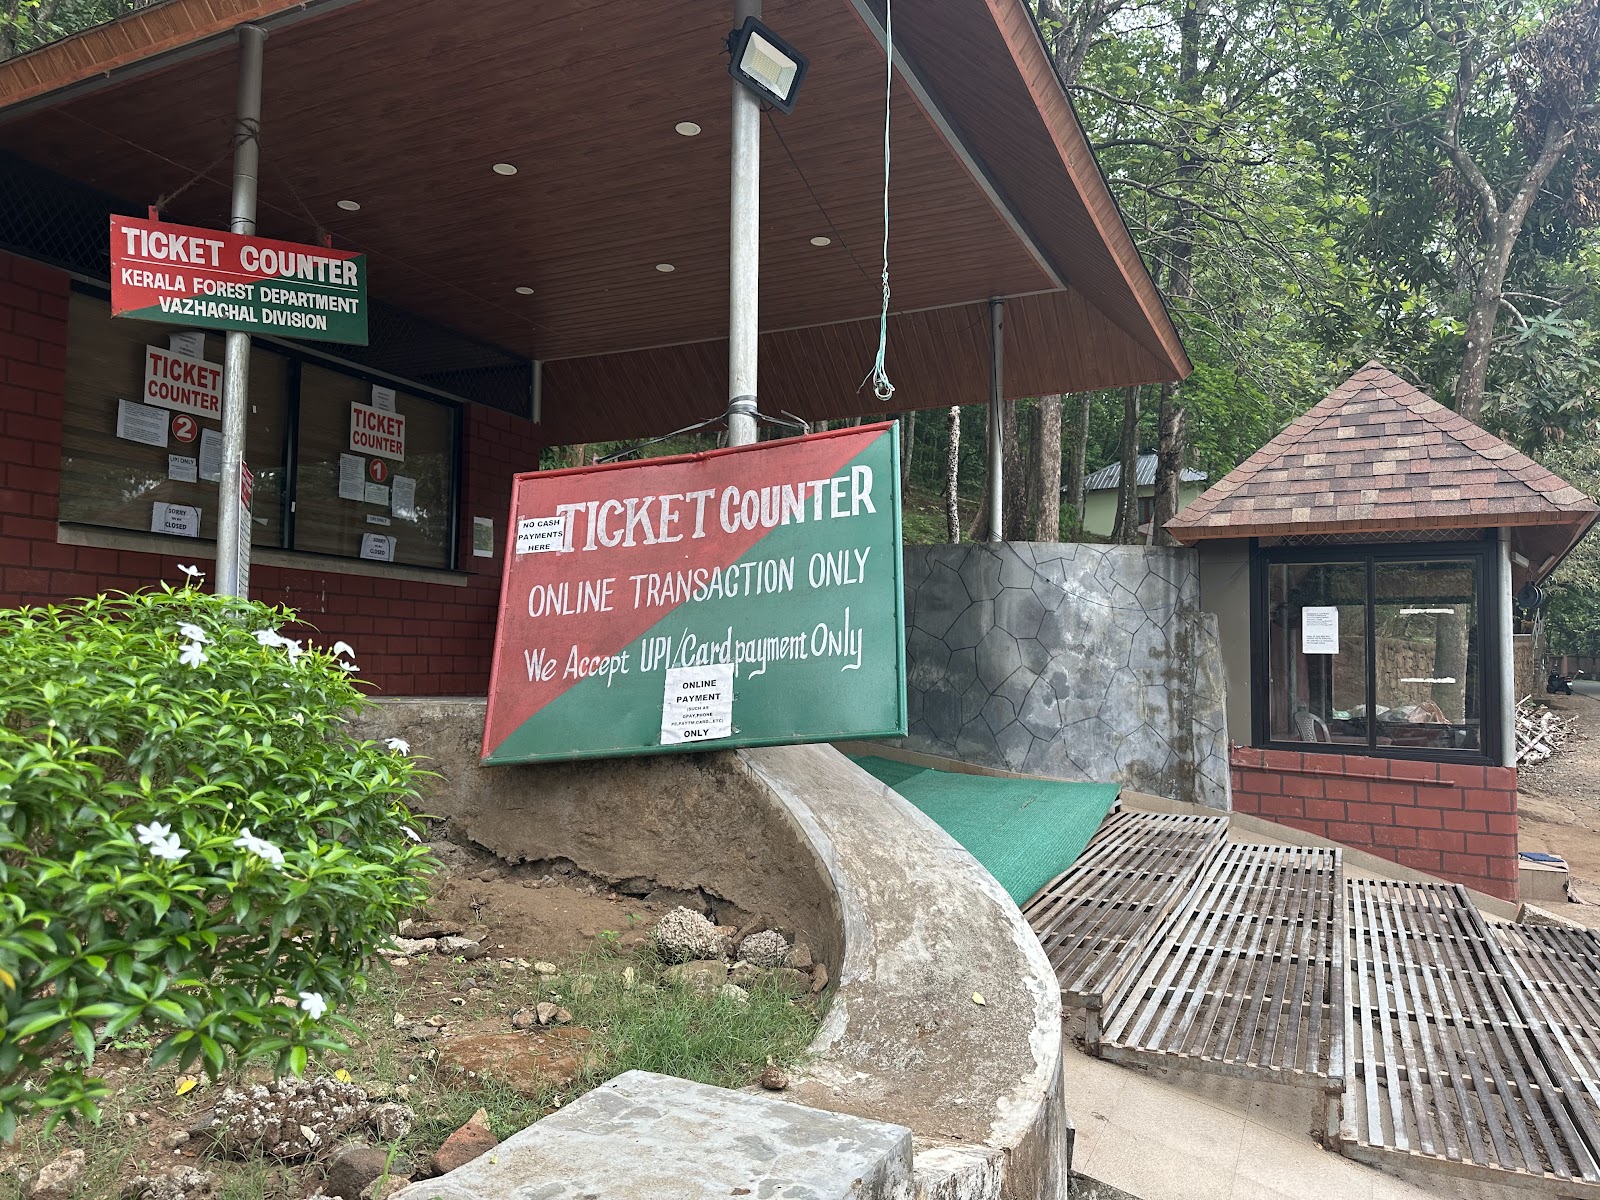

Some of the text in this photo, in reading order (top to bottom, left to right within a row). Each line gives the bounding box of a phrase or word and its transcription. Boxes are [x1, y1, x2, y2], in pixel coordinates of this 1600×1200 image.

[121, 226, 358, 287] TICKET COUNTER
[121, 267, 359, 314] KERALA FOREST DEPARTMENT
[159, 295, 327, 331] VAZHACHAL DIVISION
[149, 352, 221, 391] TICKET
[148, 379, 219, 412] COUNTER
[176, 417, 192, 439] 2
[353, 407, 404, 437] TICKET
[352, 430, 403, 455] COUNTER
[373, 462, 382, 480] 1
[555, 465, 877, 553] TICKET COUNTER
[518, 530, 563, 541] PAYMENTS
[522, 519, 560, 529] NO CASH
[527, 543, 551, 551] HERE
[528, 546, 871, 618] ONLINE TRANSACTION ONLY
[523, 647, 557, 682] We
[562, 644, 631, 688] Accept
[735, 631, 809, 681] payment
[811, 606, 863, 672] Only
[676, 692, 721, 703] PAYMENT
[682, 680, 716, 689] ONLINE
[684, 729, 709, 737] ONLY
